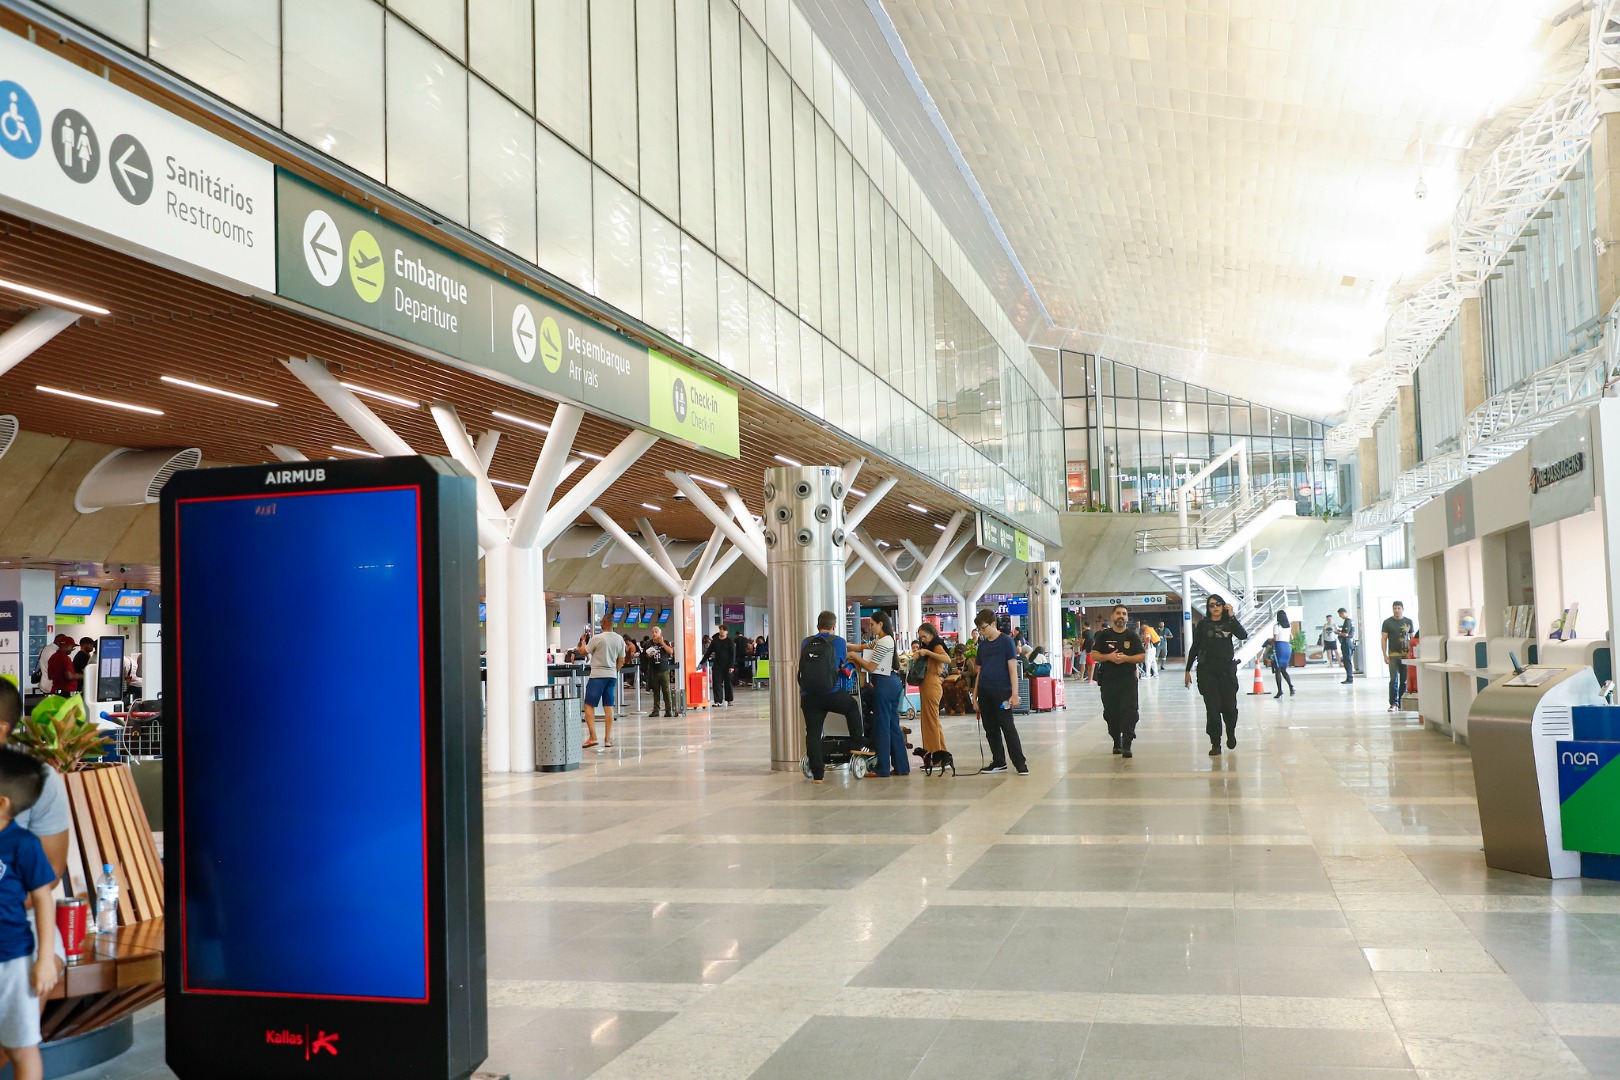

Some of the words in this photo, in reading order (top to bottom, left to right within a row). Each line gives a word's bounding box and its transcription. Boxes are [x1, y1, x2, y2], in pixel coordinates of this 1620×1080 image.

[166, 155, 253, 215] Sanitários
[167, 190, 254, 248] Restrooms
[394, 248, 468, 305] Embarque
[395, 286, 458, 333] Departure
[567, 327, 631, 376] Desembarque
[569, 359, 599, 388] Arrvals
[690, 386, 718, 414] Check-in
[265, 468, 326, 485] AIRMUB
[266, 1029, 303, 1045] Kallas
